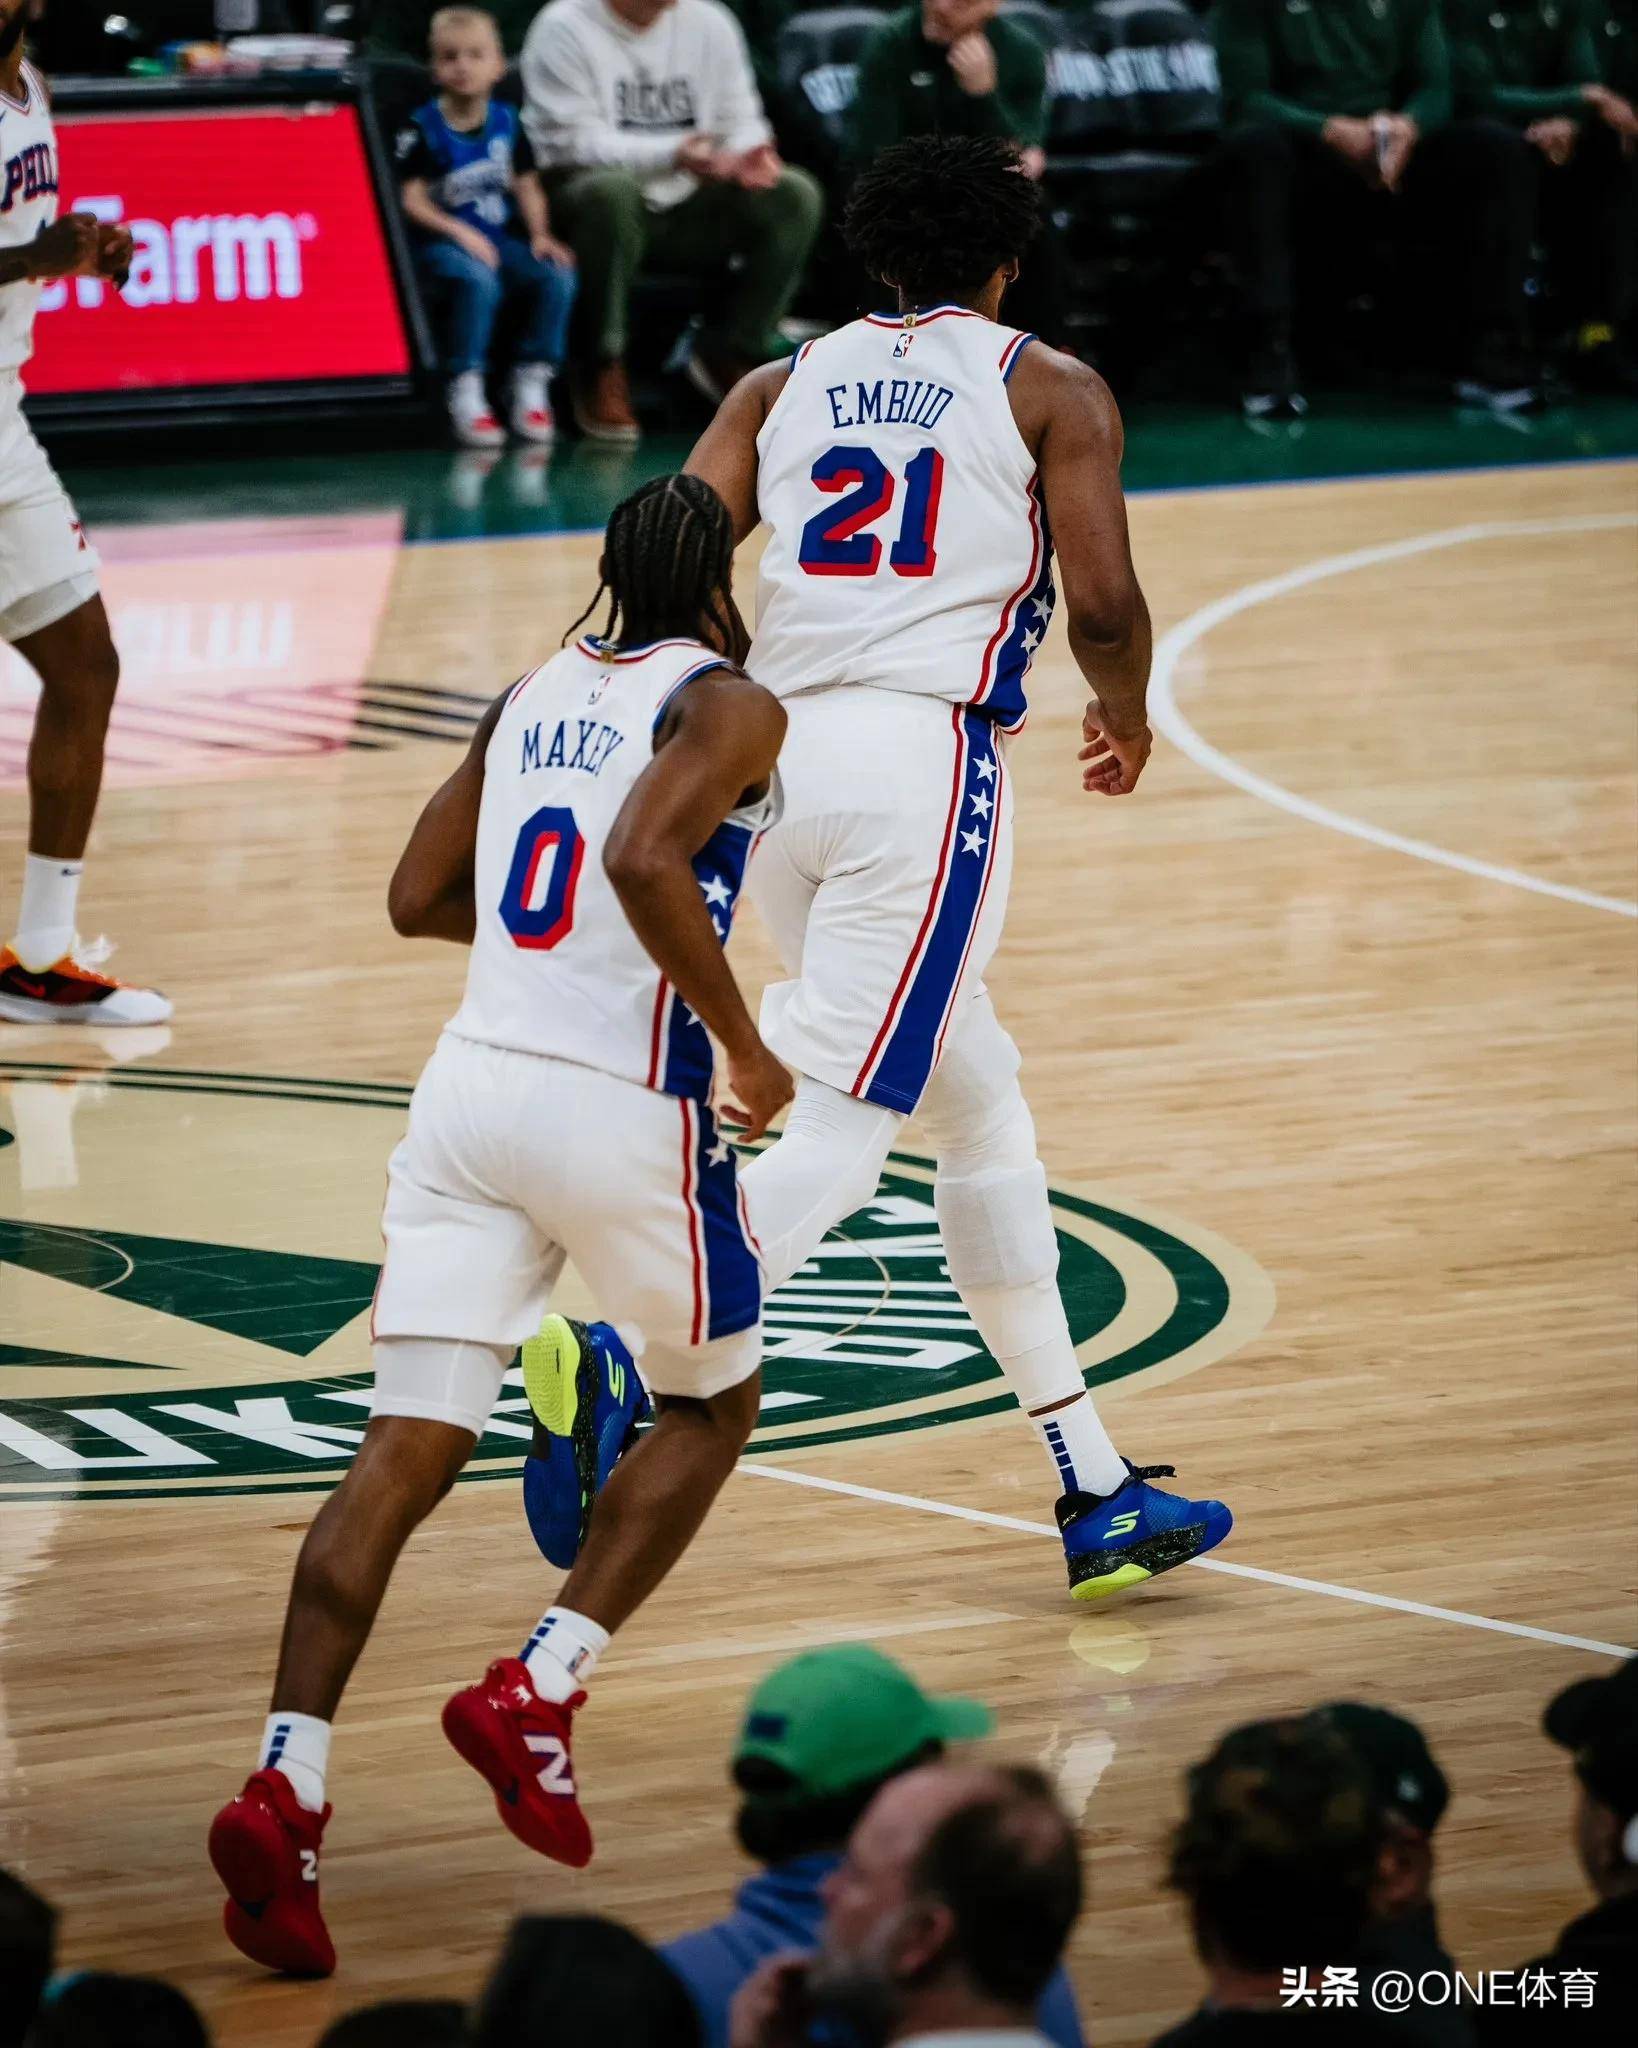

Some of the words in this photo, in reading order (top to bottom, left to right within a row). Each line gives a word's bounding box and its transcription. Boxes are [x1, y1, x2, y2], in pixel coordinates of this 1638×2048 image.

[826, 379, 954, 430] EMBIID
[798, 445, 945, 577] 21
[520, 720, 623, 776] MAXEY
[498, 806, 586, 951] 0
